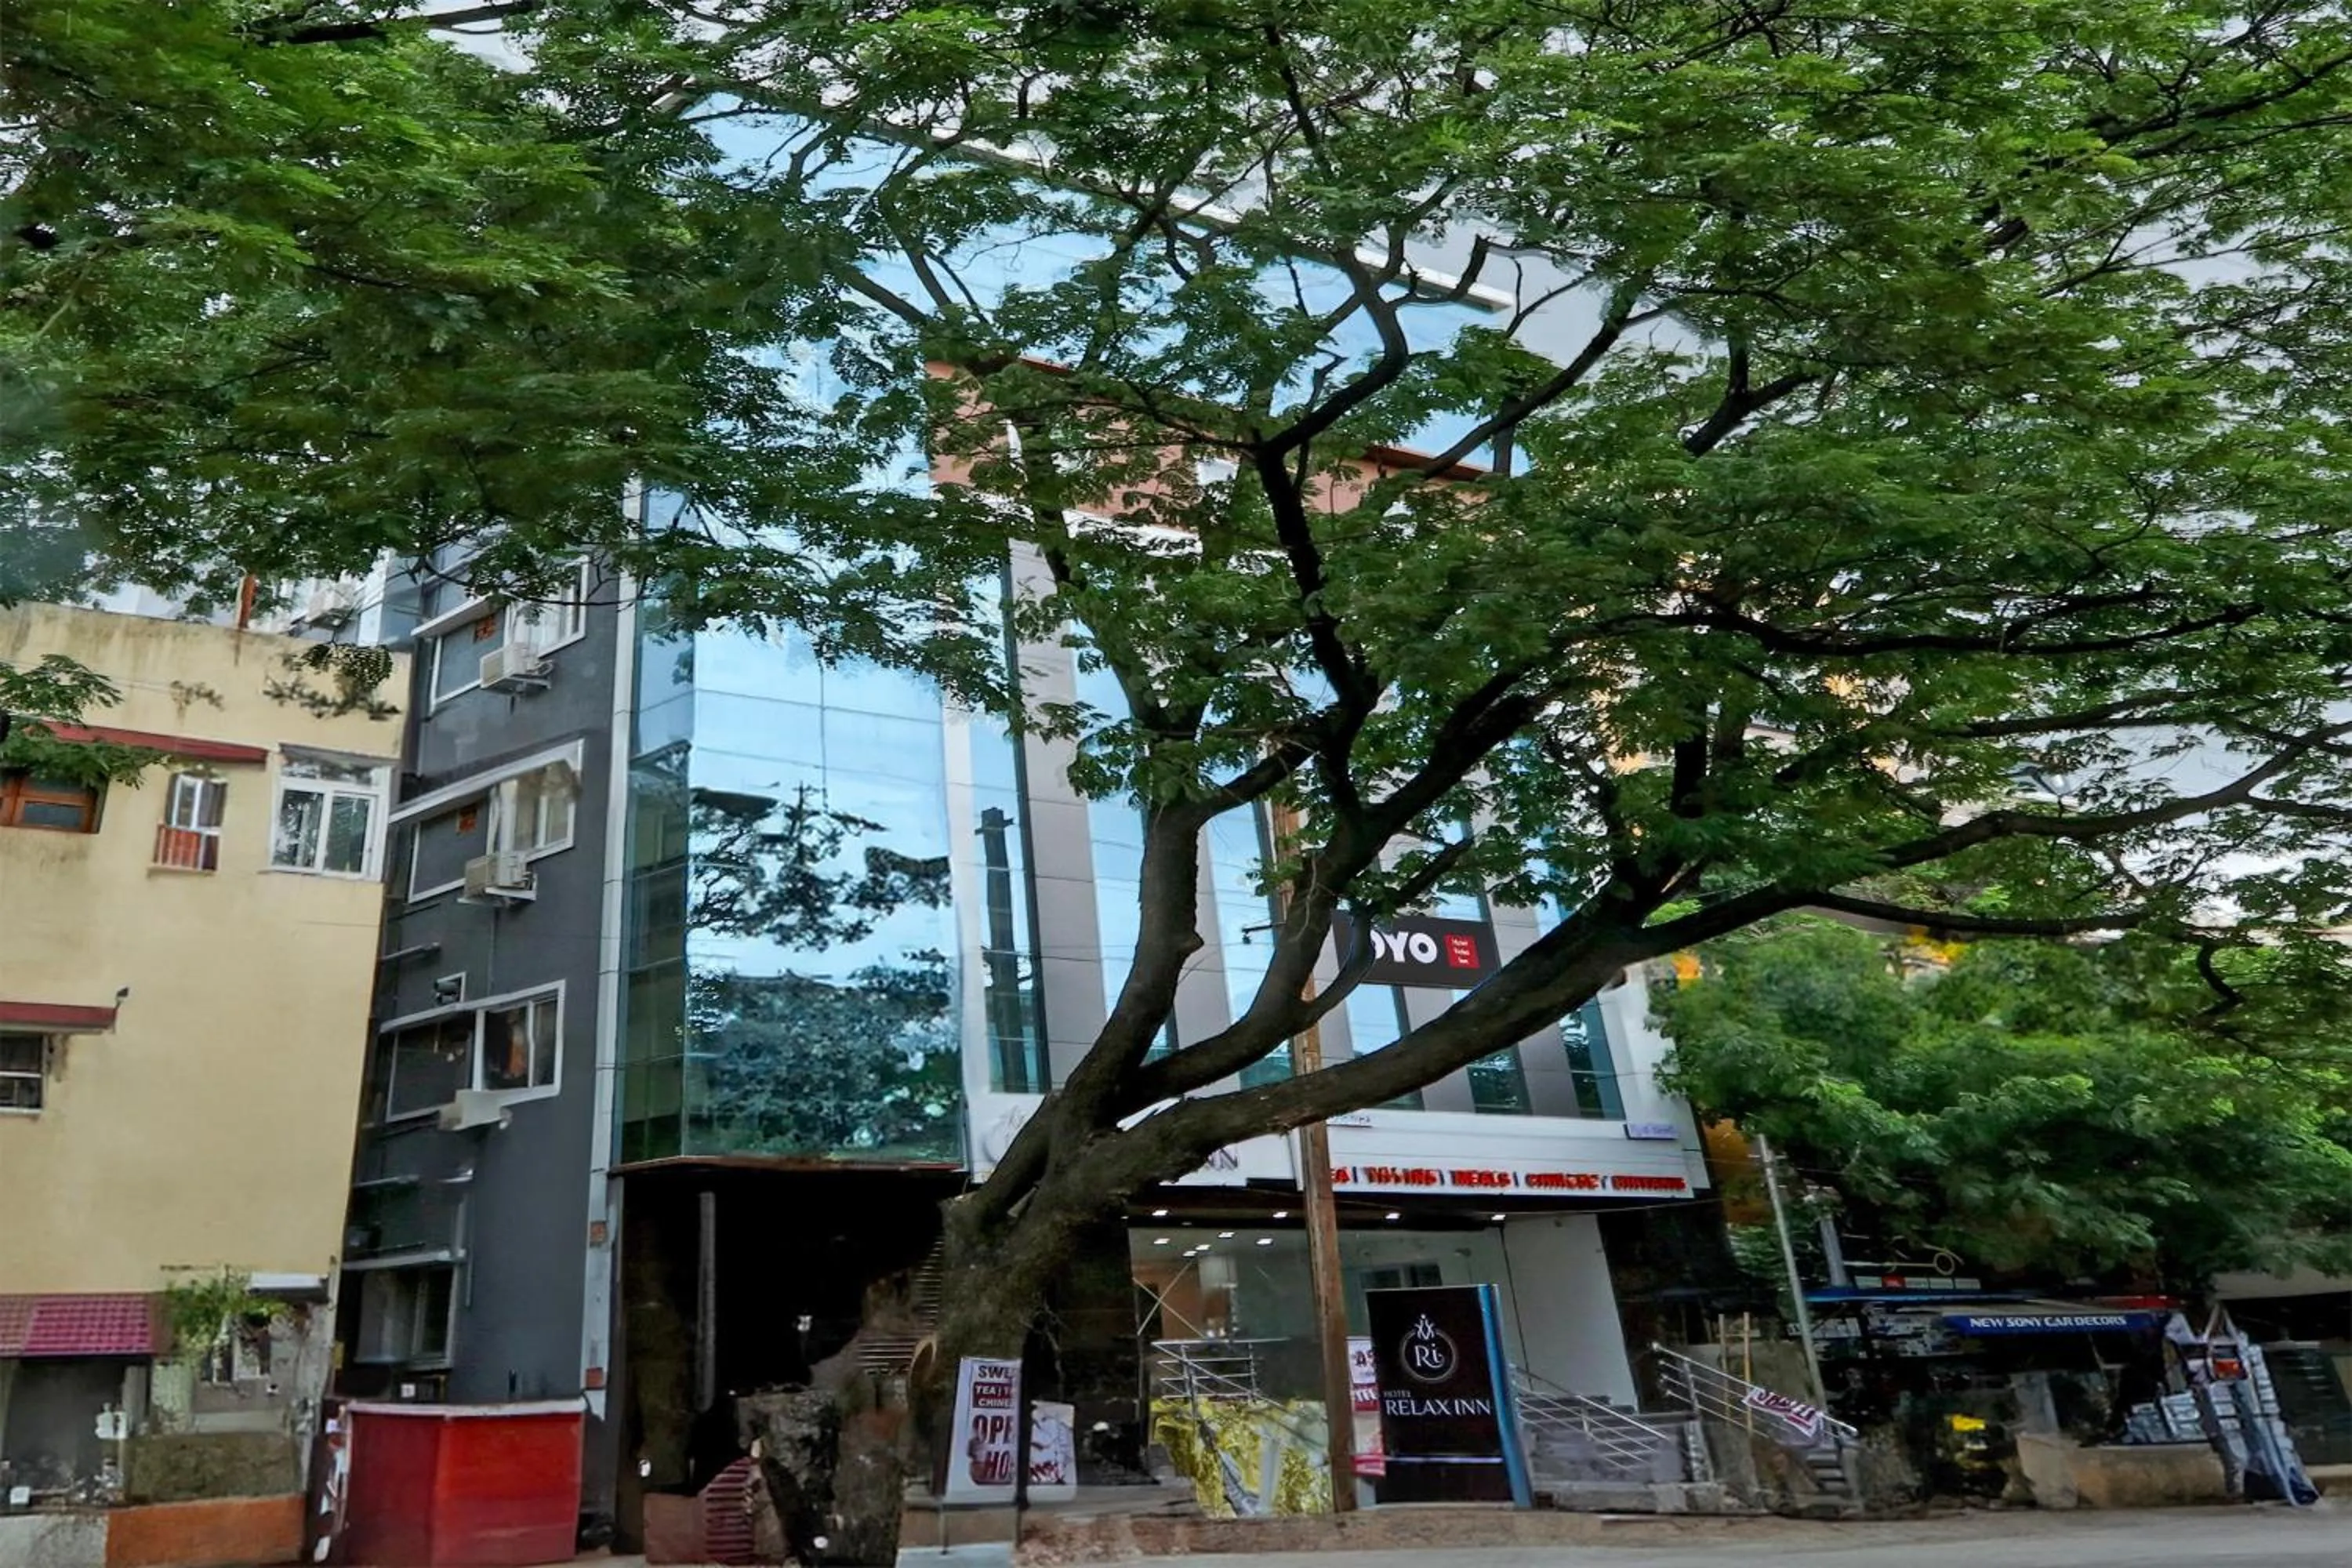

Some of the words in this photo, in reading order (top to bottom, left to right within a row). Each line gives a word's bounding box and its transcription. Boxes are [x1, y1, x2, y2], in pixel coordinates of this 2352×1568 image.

[1969, 1317, 2002, 1327] NEW
[2006, 1317, 2042, 1327] SONY
[2044, 1316, 2076, 1327] CAR
[2077, 1316, 2127, 1326] DECORS
[1385, 1399, 1450, 1415] RELAX
[1454, 1399, 1491, 1416] INN
